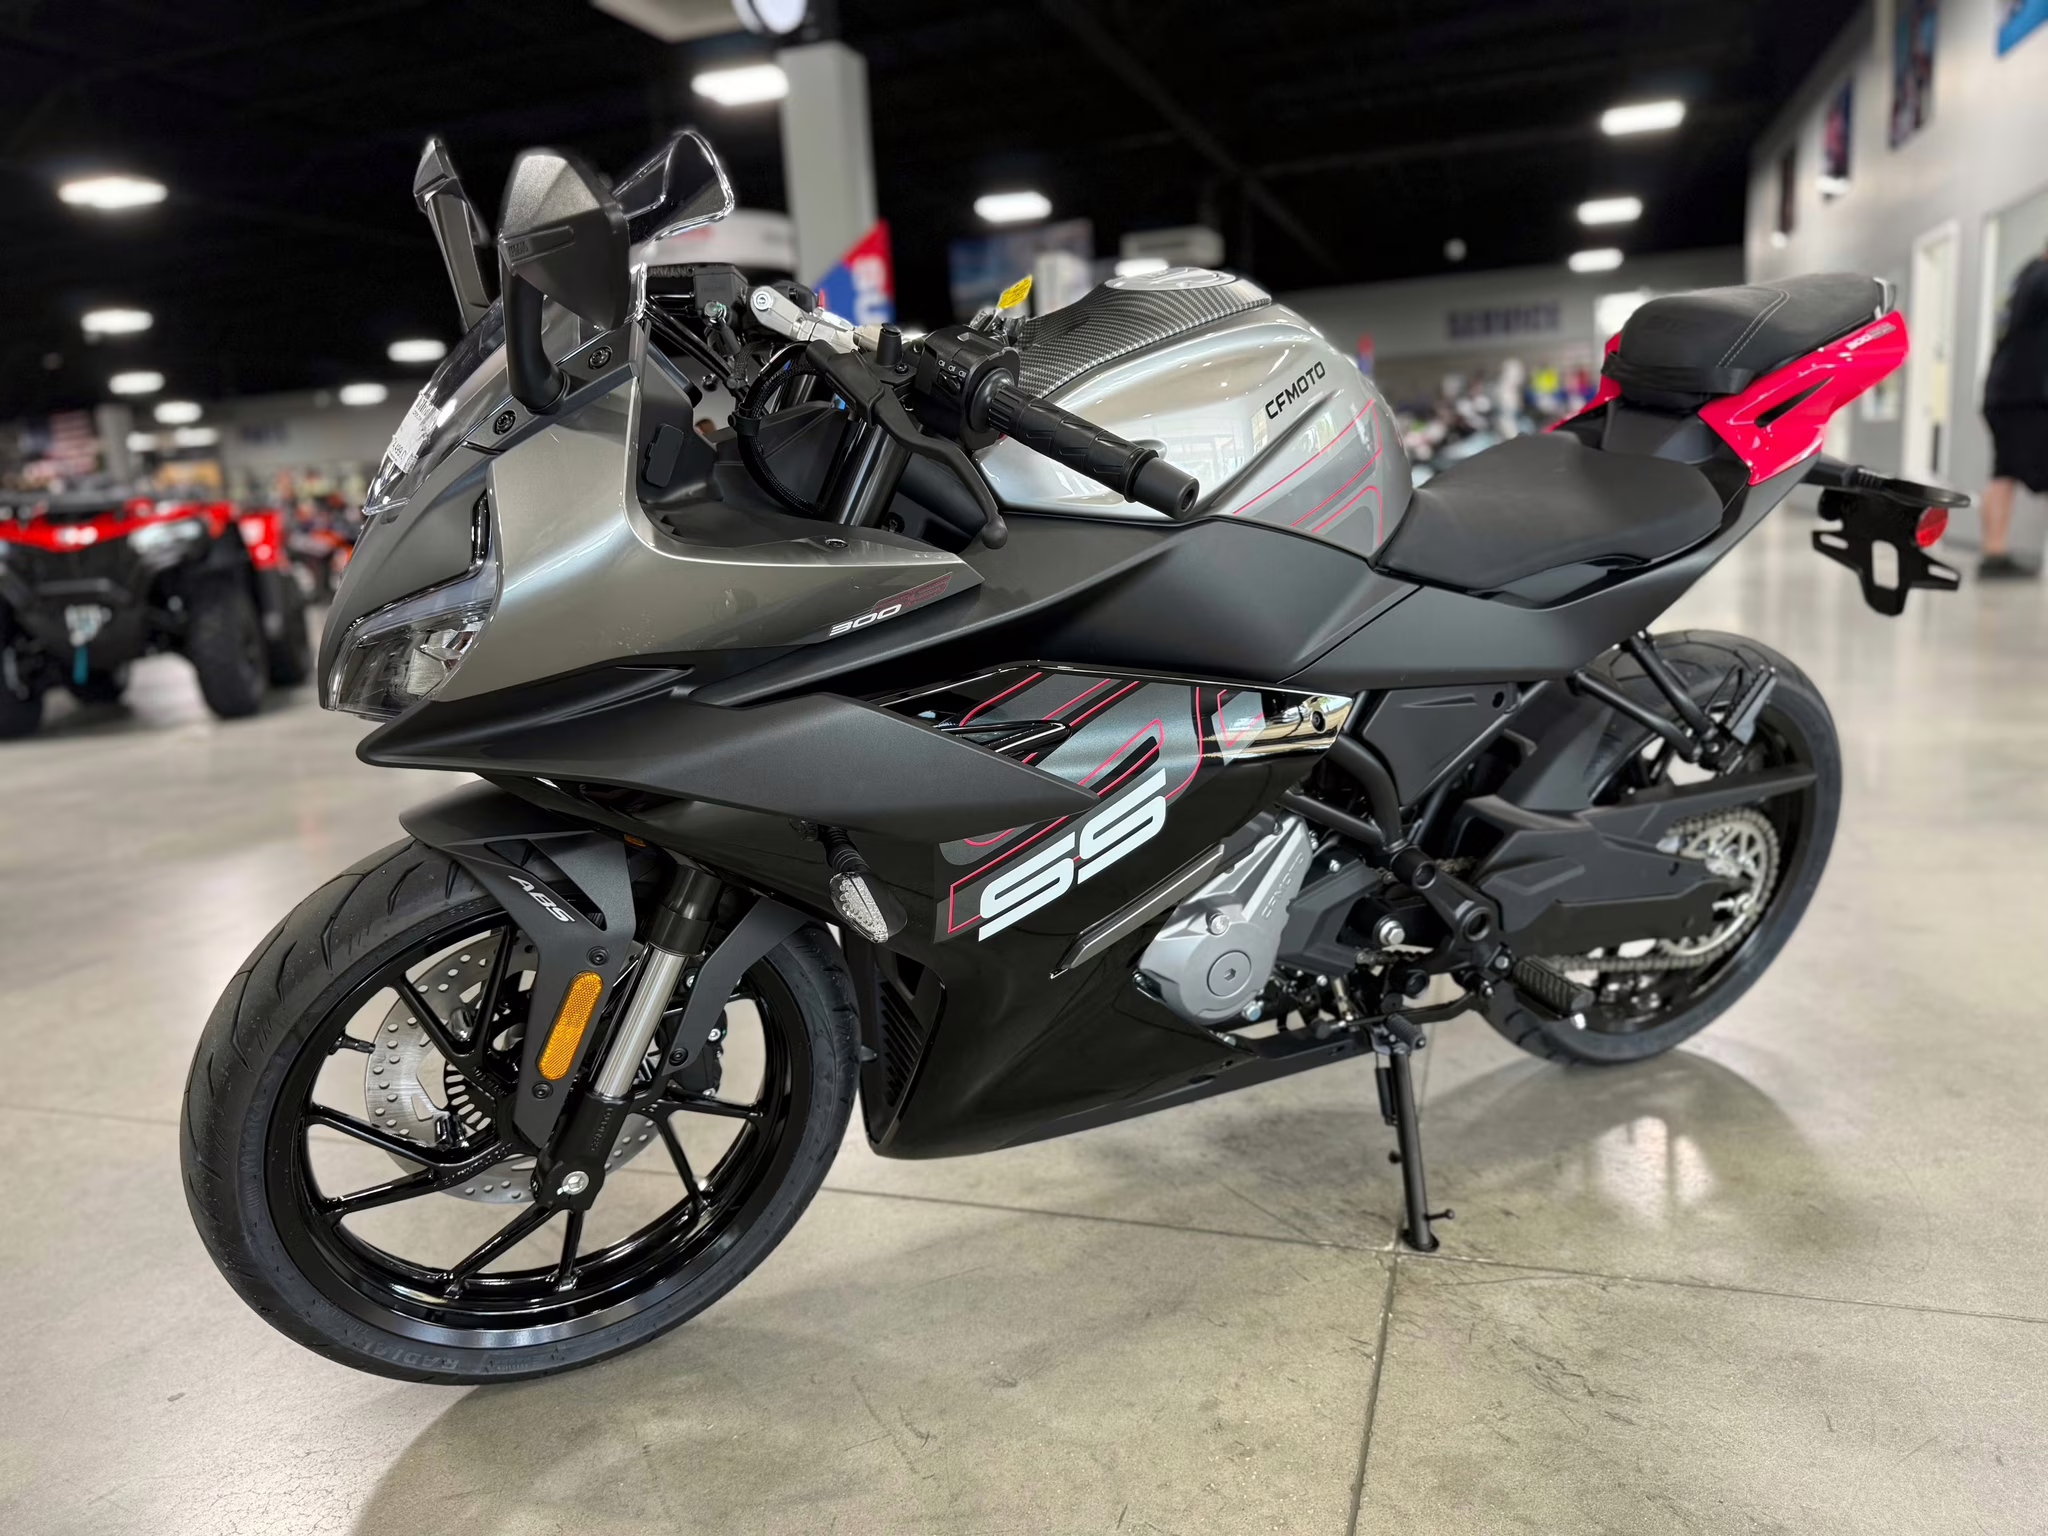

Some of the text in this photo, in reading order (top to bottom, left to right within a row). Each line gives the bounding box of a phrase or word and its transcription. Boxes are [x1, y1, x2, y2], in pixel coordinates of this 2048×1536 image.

[1265, 361, 1326, 420] CFMOTO
[978, 768, 1167, 942] SS
[508, 875, 576, 922] ABS
[359, 1336, 459, 1370] RADIAL
